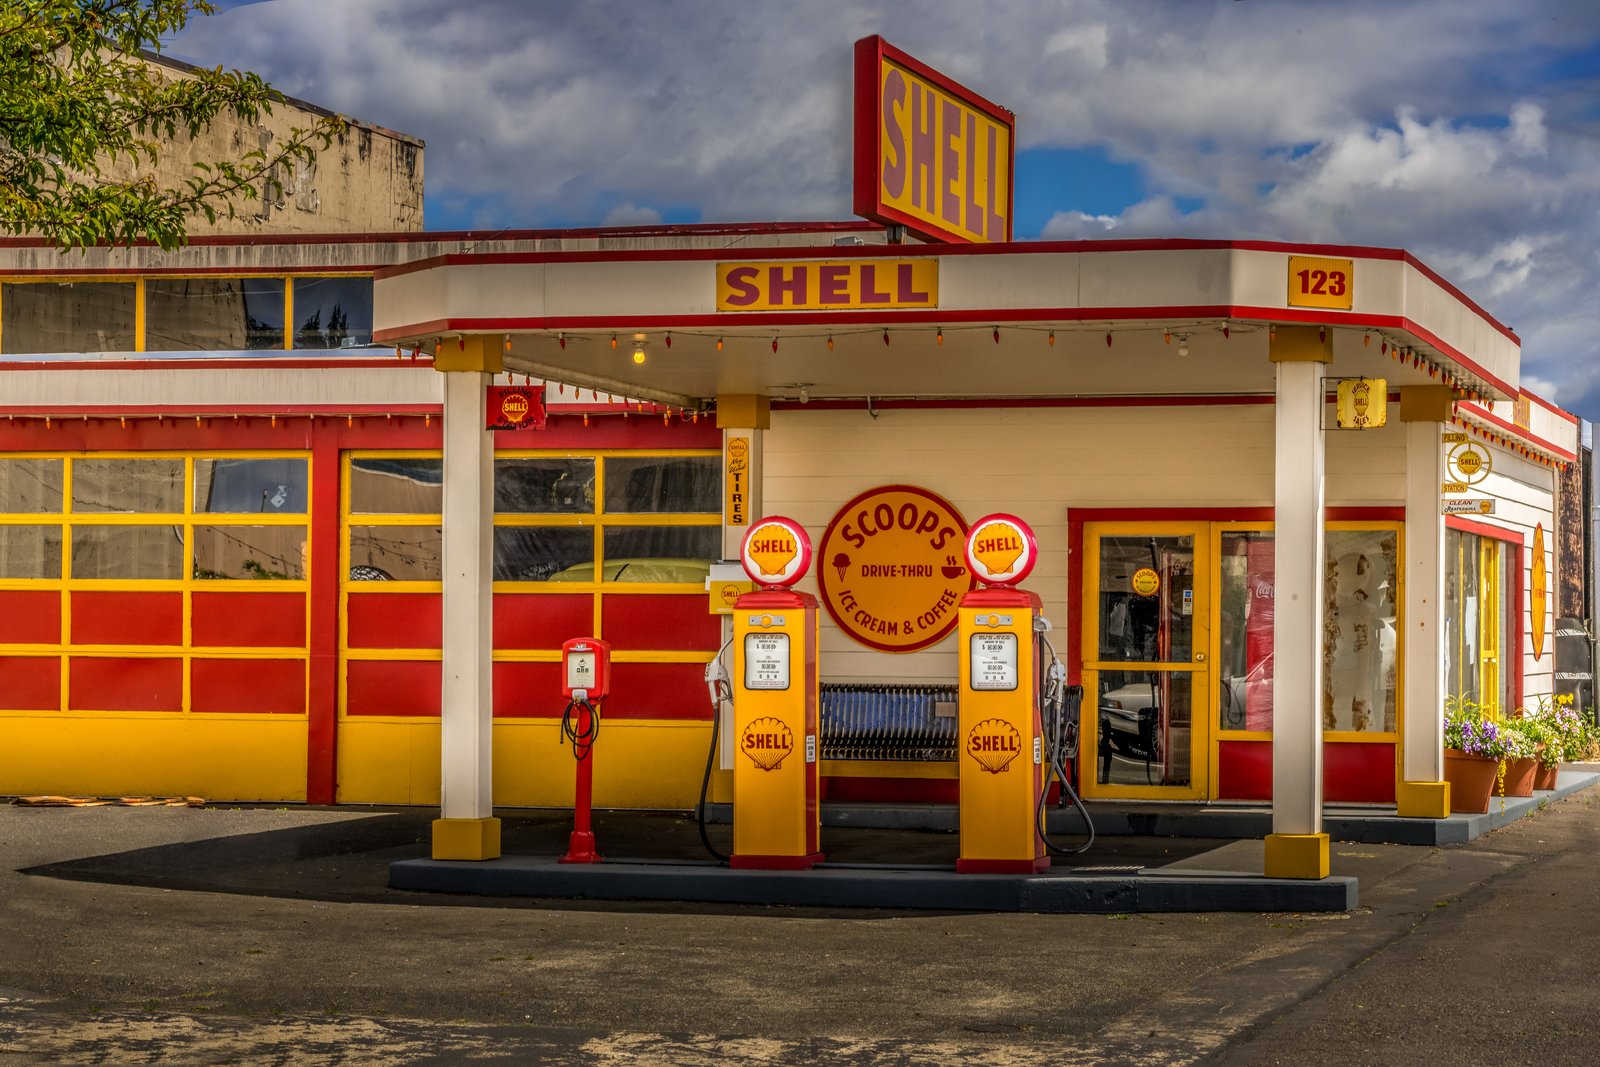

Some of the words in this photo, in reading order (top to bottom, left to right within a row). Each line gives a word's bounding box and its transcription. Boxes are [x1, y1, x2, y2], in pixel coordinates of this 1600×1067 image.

[882, 68, 1005, 242] SHELL
[725, 264, 929, 306] SHELL
[1297, 269, 1346, 296] 123
[498, 386, 533, 399] FILLING
[504, 402, 526, 412] SHELL
[1355, 397, 1368, 406] SHELL
[1353, 415, 1370, 426] SALES
[1443, 433, 1466, 442] FILLING
[1460, 458, 1480, 466] SHELL
[732, 472, 743, 523] TIRES
[841, 503, 956, 550] SCOOPS
[752, 539, 793, 554] SHELL
[977, 536, 1020, 554] SHELL
[861, 565, 933, 577] DRIVE-THRU
[1136, 570, 1156, 580] SCOOPS
[722, 590, 739, 598] SHELL
[838, 590, 858, 613] ICE
[854, 610, 898, 636] CREAM
[903, 620, 915, 635] &
[916, 588, 958, 630] COFFEE
[745, 733, 789, 749] SHELL
[971, 735, 1017, 751] SHELL
